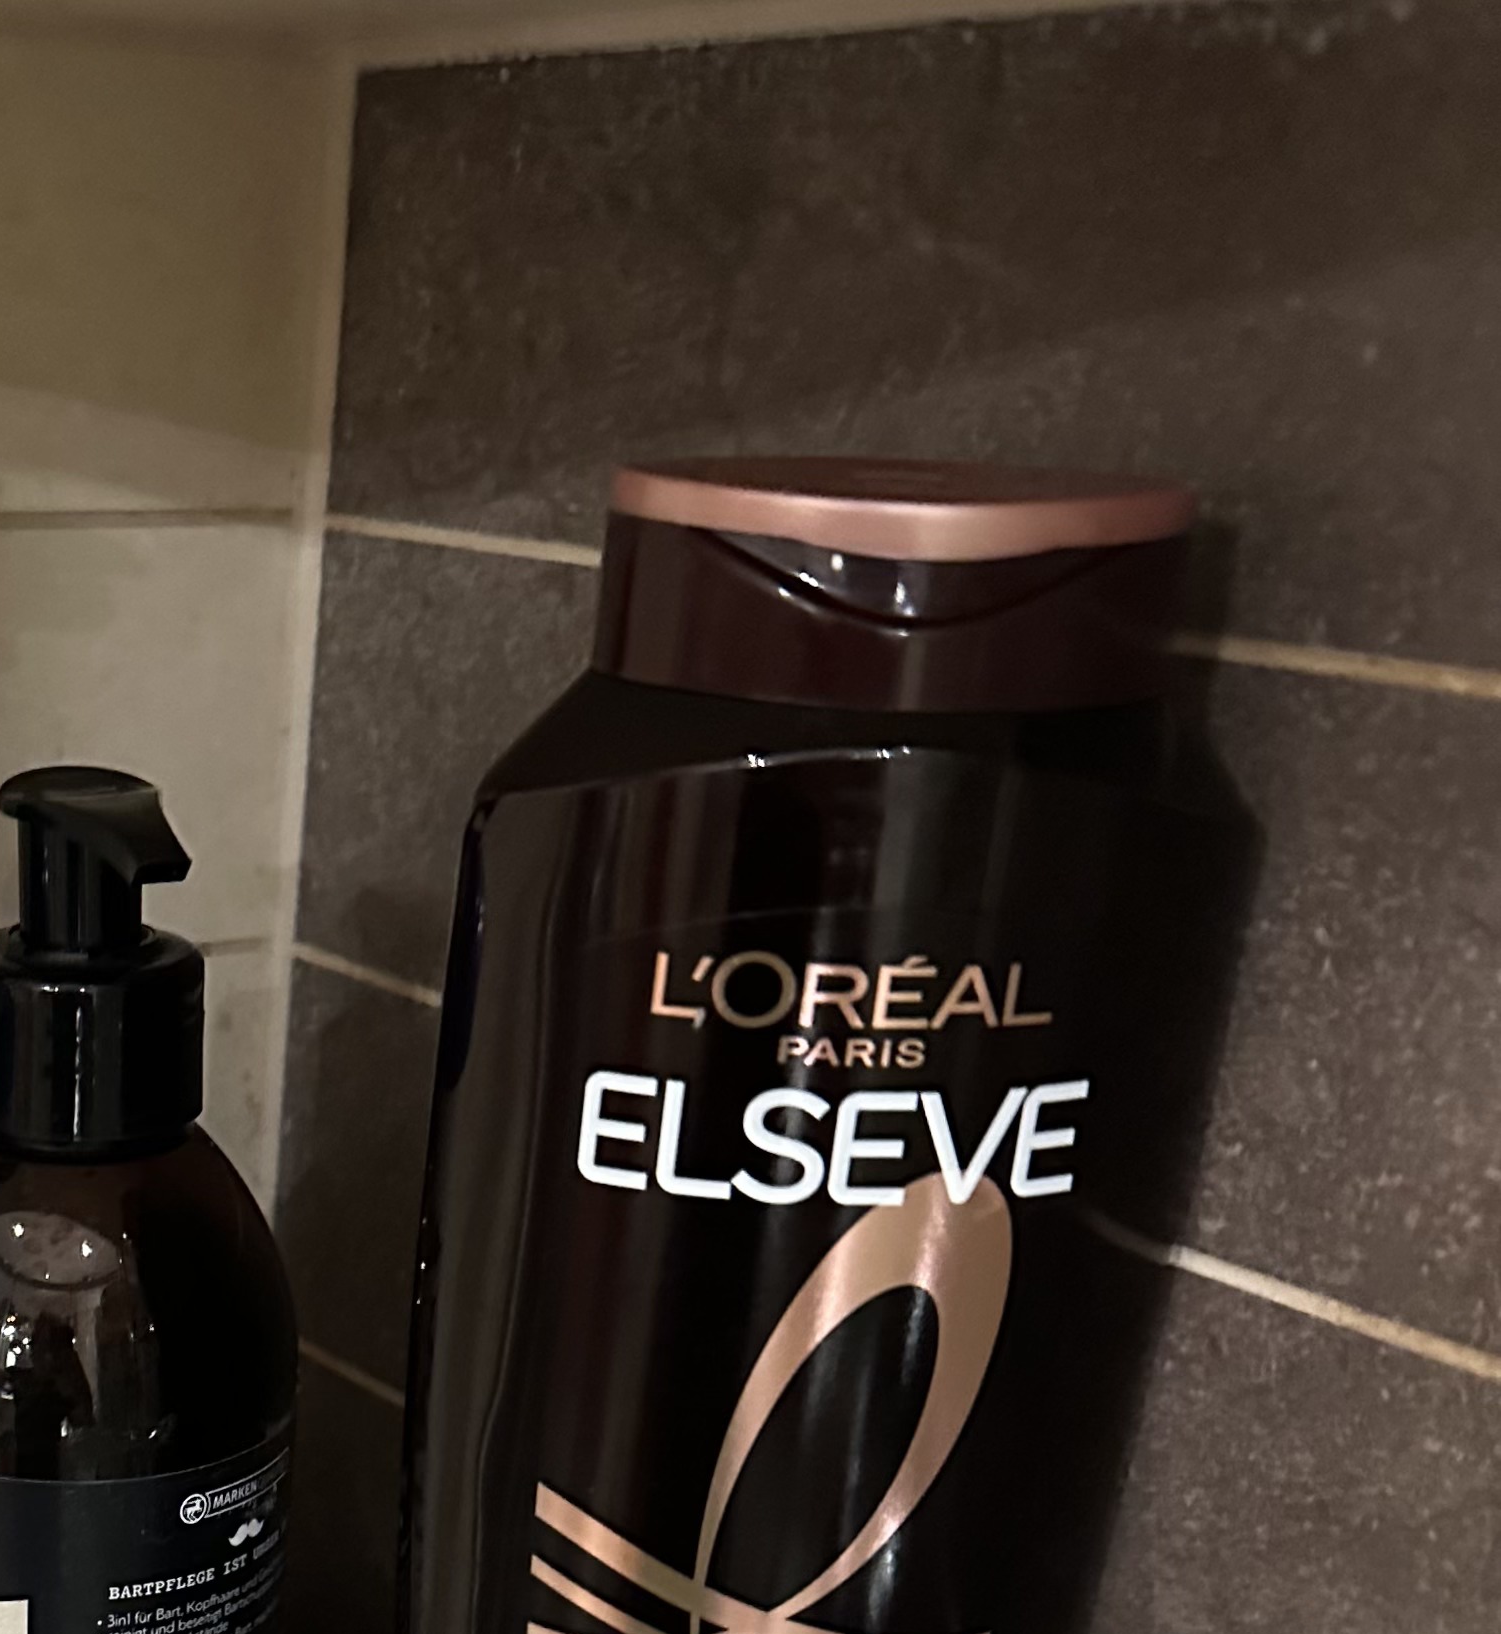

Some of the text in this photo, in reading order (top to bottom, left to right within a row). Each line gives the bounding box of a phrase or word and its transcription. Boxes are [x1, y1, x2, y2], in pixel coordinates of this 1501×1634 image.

[650, 949, 1052, 1031] L'ORÉAL
[777, 1035, 926, 1070] PARIS
[577, 1070, 1090, 1207] ELSEVE
[108, 1568, 216, 1600] BARTPFLEGE
[223, 1553, 248, 1576] IST
[134, 1612, 151, 1624] für
[186, 1586, 240, 1614] Kopfhaare
